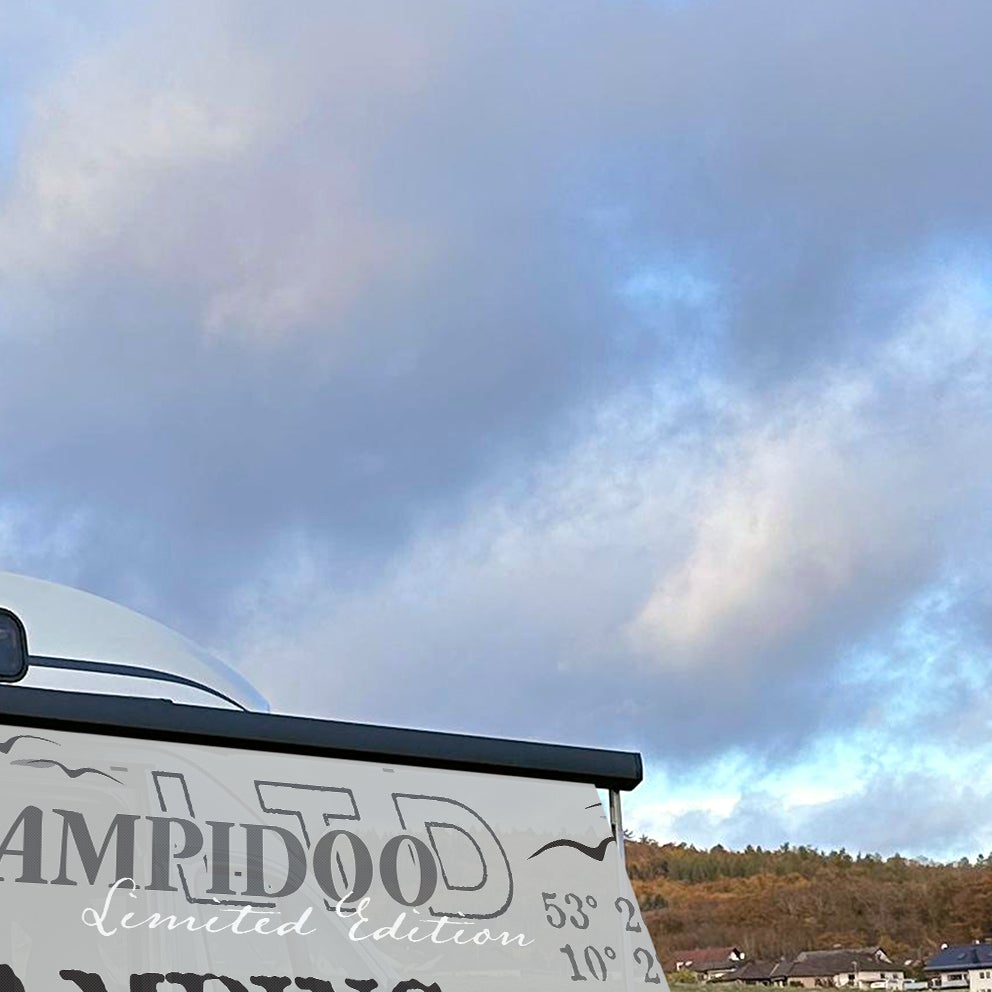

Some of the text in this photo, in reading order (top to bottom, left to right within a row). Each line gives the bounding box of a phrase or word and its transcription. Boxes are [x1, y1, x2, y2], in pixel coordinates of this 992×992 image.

[81, 877, 536, 947] Limited Edition
[614, 896, 642, 933] 2
[633, 947, 661, 985] 2
